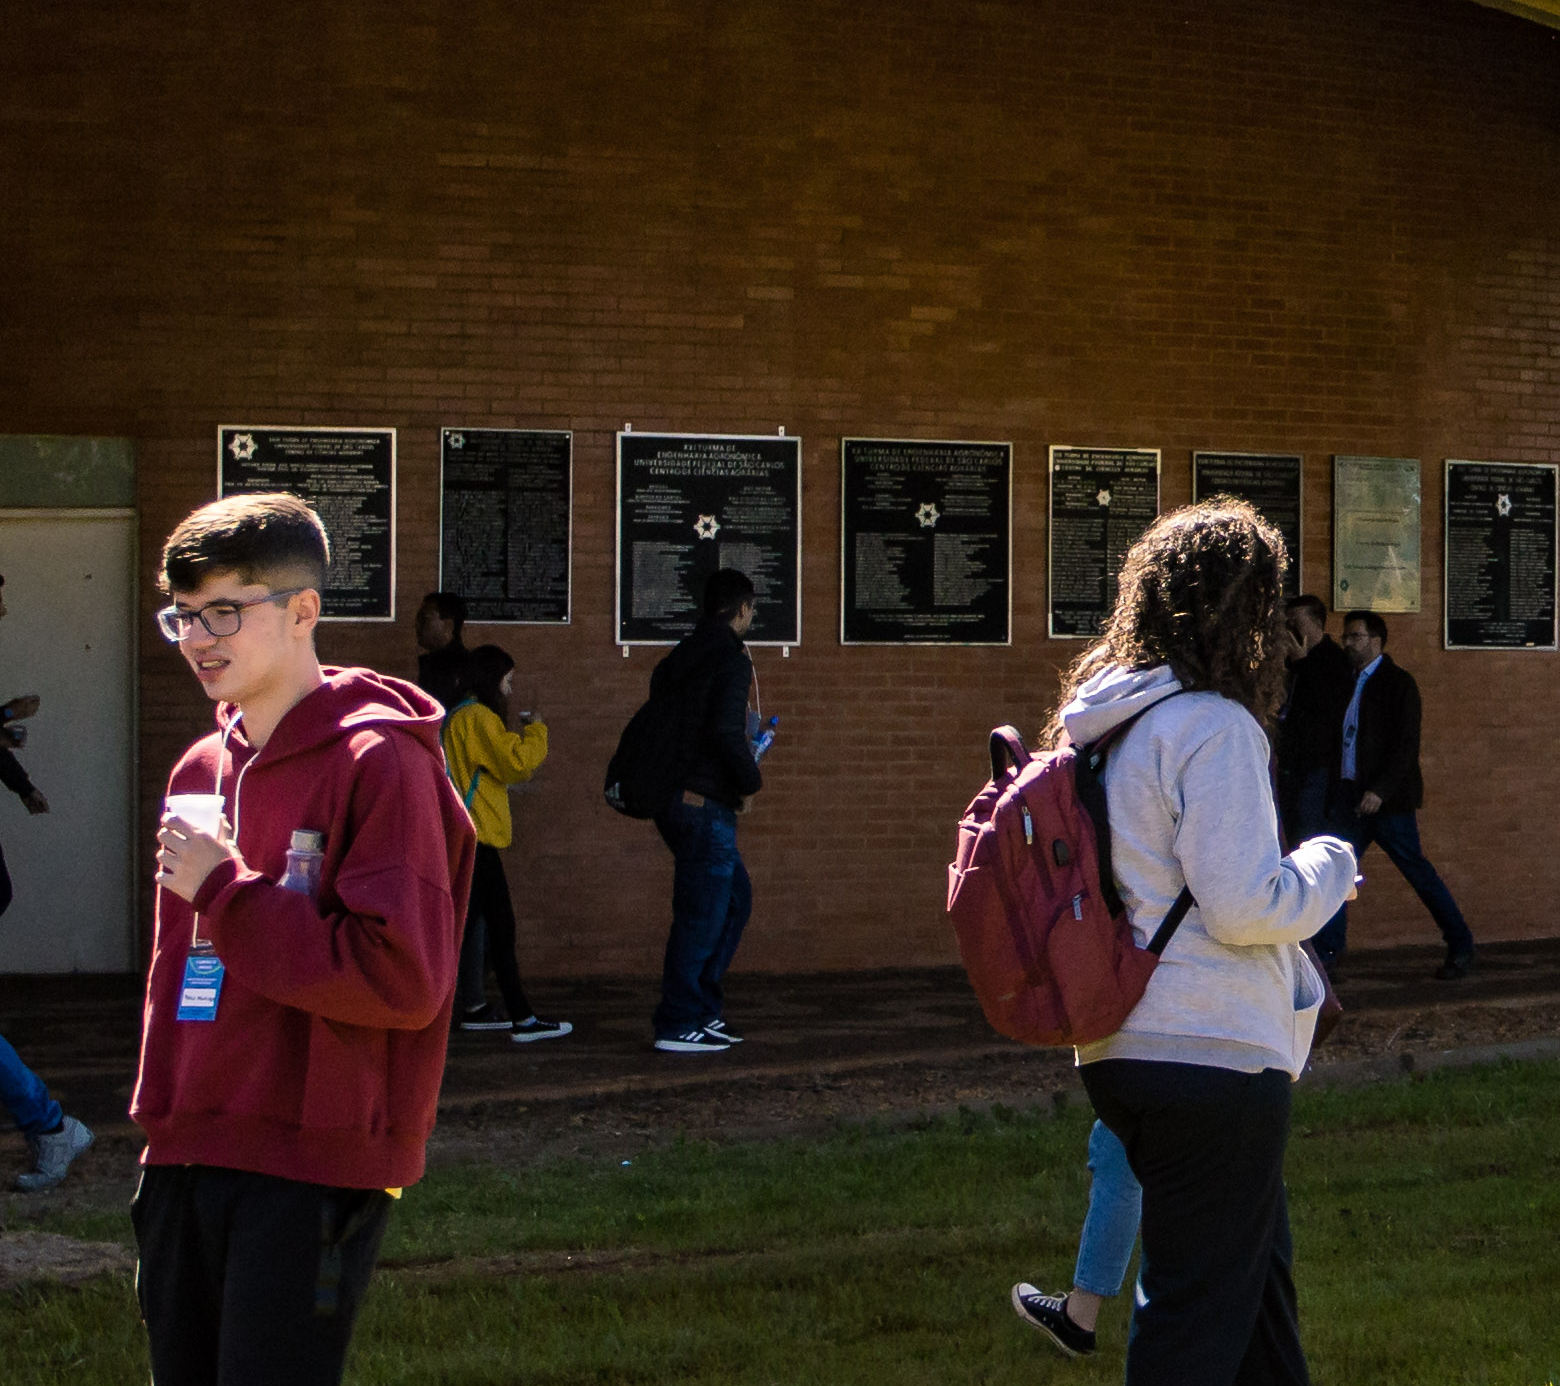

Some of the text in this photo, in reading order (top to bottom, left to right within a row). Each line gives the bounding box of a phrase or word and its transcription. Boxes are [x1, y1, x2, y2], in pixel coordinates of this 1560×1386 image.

[657, 451, 708, 459] ENGENHARIA
[634, 459, 691, 467] UNIVERSIDADE
[692, 460, 725, 468] FEDERAL
[739, 459, 755, 469] SÃO
[755, 461, 785, 469] CARLOS
